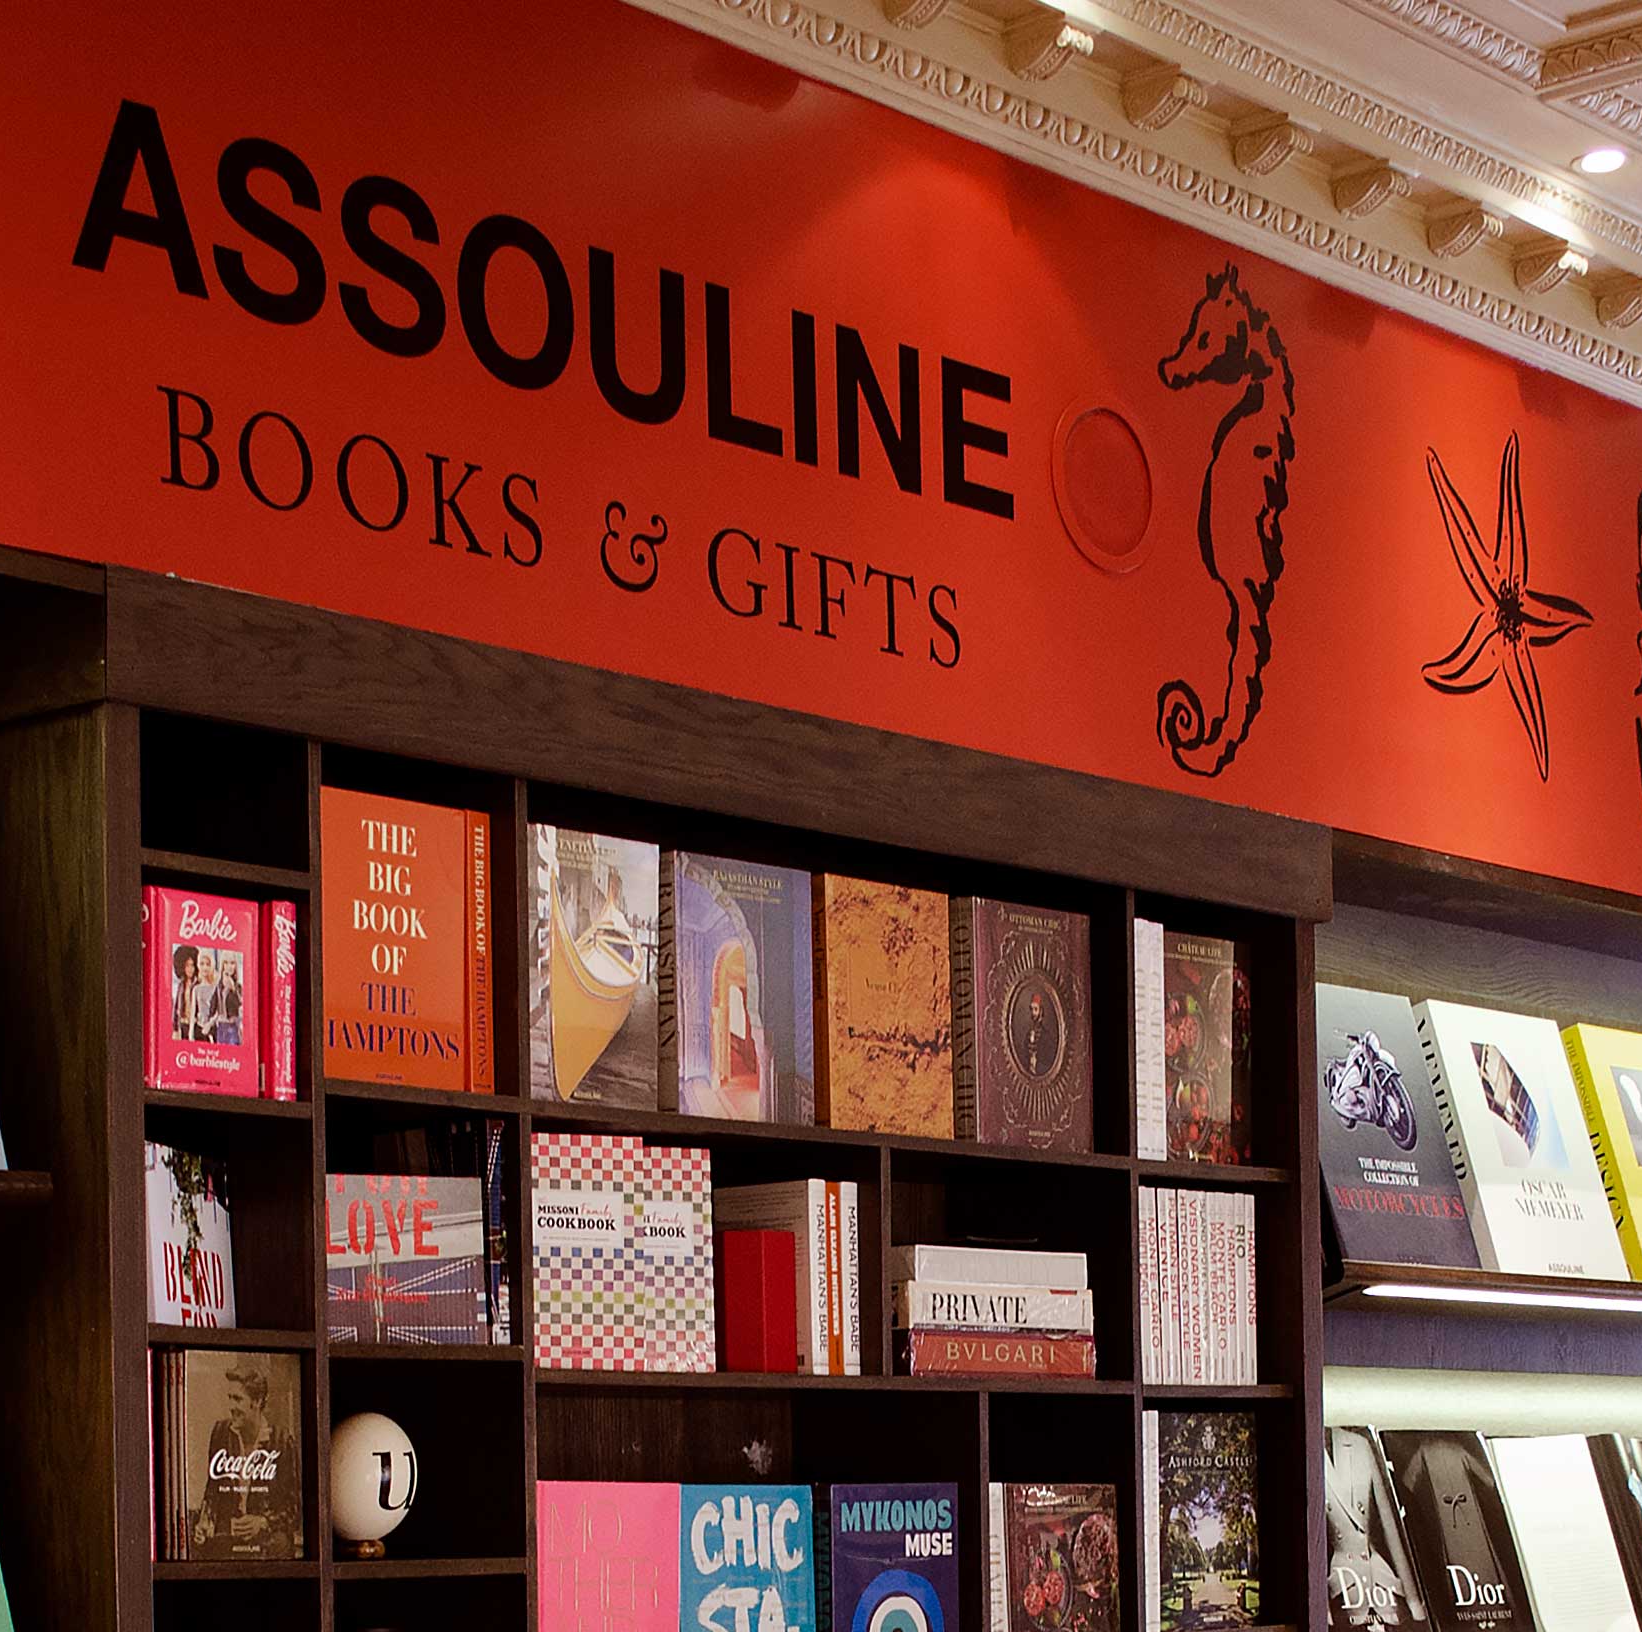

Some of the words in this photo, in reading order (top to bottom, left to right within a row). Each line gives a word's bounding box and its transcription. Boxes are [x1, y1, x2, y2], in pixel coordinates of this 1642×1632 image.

[73, 98, 1015, 520] ASSOULINE
[157, 384, 543, 567] BOOKS
[600, 501, 669, 592] &
[707, 527, 961, 669] GIFTS
[361, 819, 417, 858] THE
[368, 861, 411, 897] BIG
[179, 900, 237, 941] Barbie
[353, 899, 428, 939] BOOK
[371, 943, 407, 975] OF
[360, 982, 416, 1016] THE
[1333, 1186, 1465, 1220] MOTORCYCLES
[1520, 1178, 1567, 1199] OSCAR
[325, 1199, 440, 1256] LOVE
[538, 1205, 579, 1215] MISSONI
[538, 1216, 616, 1231] COOKBOOK
[1148, 1217, 1158, 1281] MONTE
[1180, 1196, 1190, 1294] HITCHCOCK
[1189, 1200, 1200, 1296] VISIONARY
[1236, 1224, 1245, 1258] RIO
[1160, 1222, 1169, 1303] VENICE
[1227, 1229, 1236, 1325] HAMPTONS
[1248, 1230, 1256, 1326] HAMPTONS
[931, 1292, 1027, 1324] PRIVATE
[1151, 1289, 1160, 1349] CARLO
[1181, 1301, 1190, 1349] STYLE
[819, 1314, 827, 1352] BABE
[850, 1315, 859, 1352] BABE
[946, 1342, 1055, 1362] BVLGARI
[1192, 1306, 1202, 1380] WOMEN
[690, 1495, 805, 1575] CHIC
[839, 1498, 953, 1533] MYKONOS
[904, 1532, 953, 1557] MUSE
[1333, 1565, 1397, 1609] Dior
[1446, 1564, 1506, 1606] Dior
